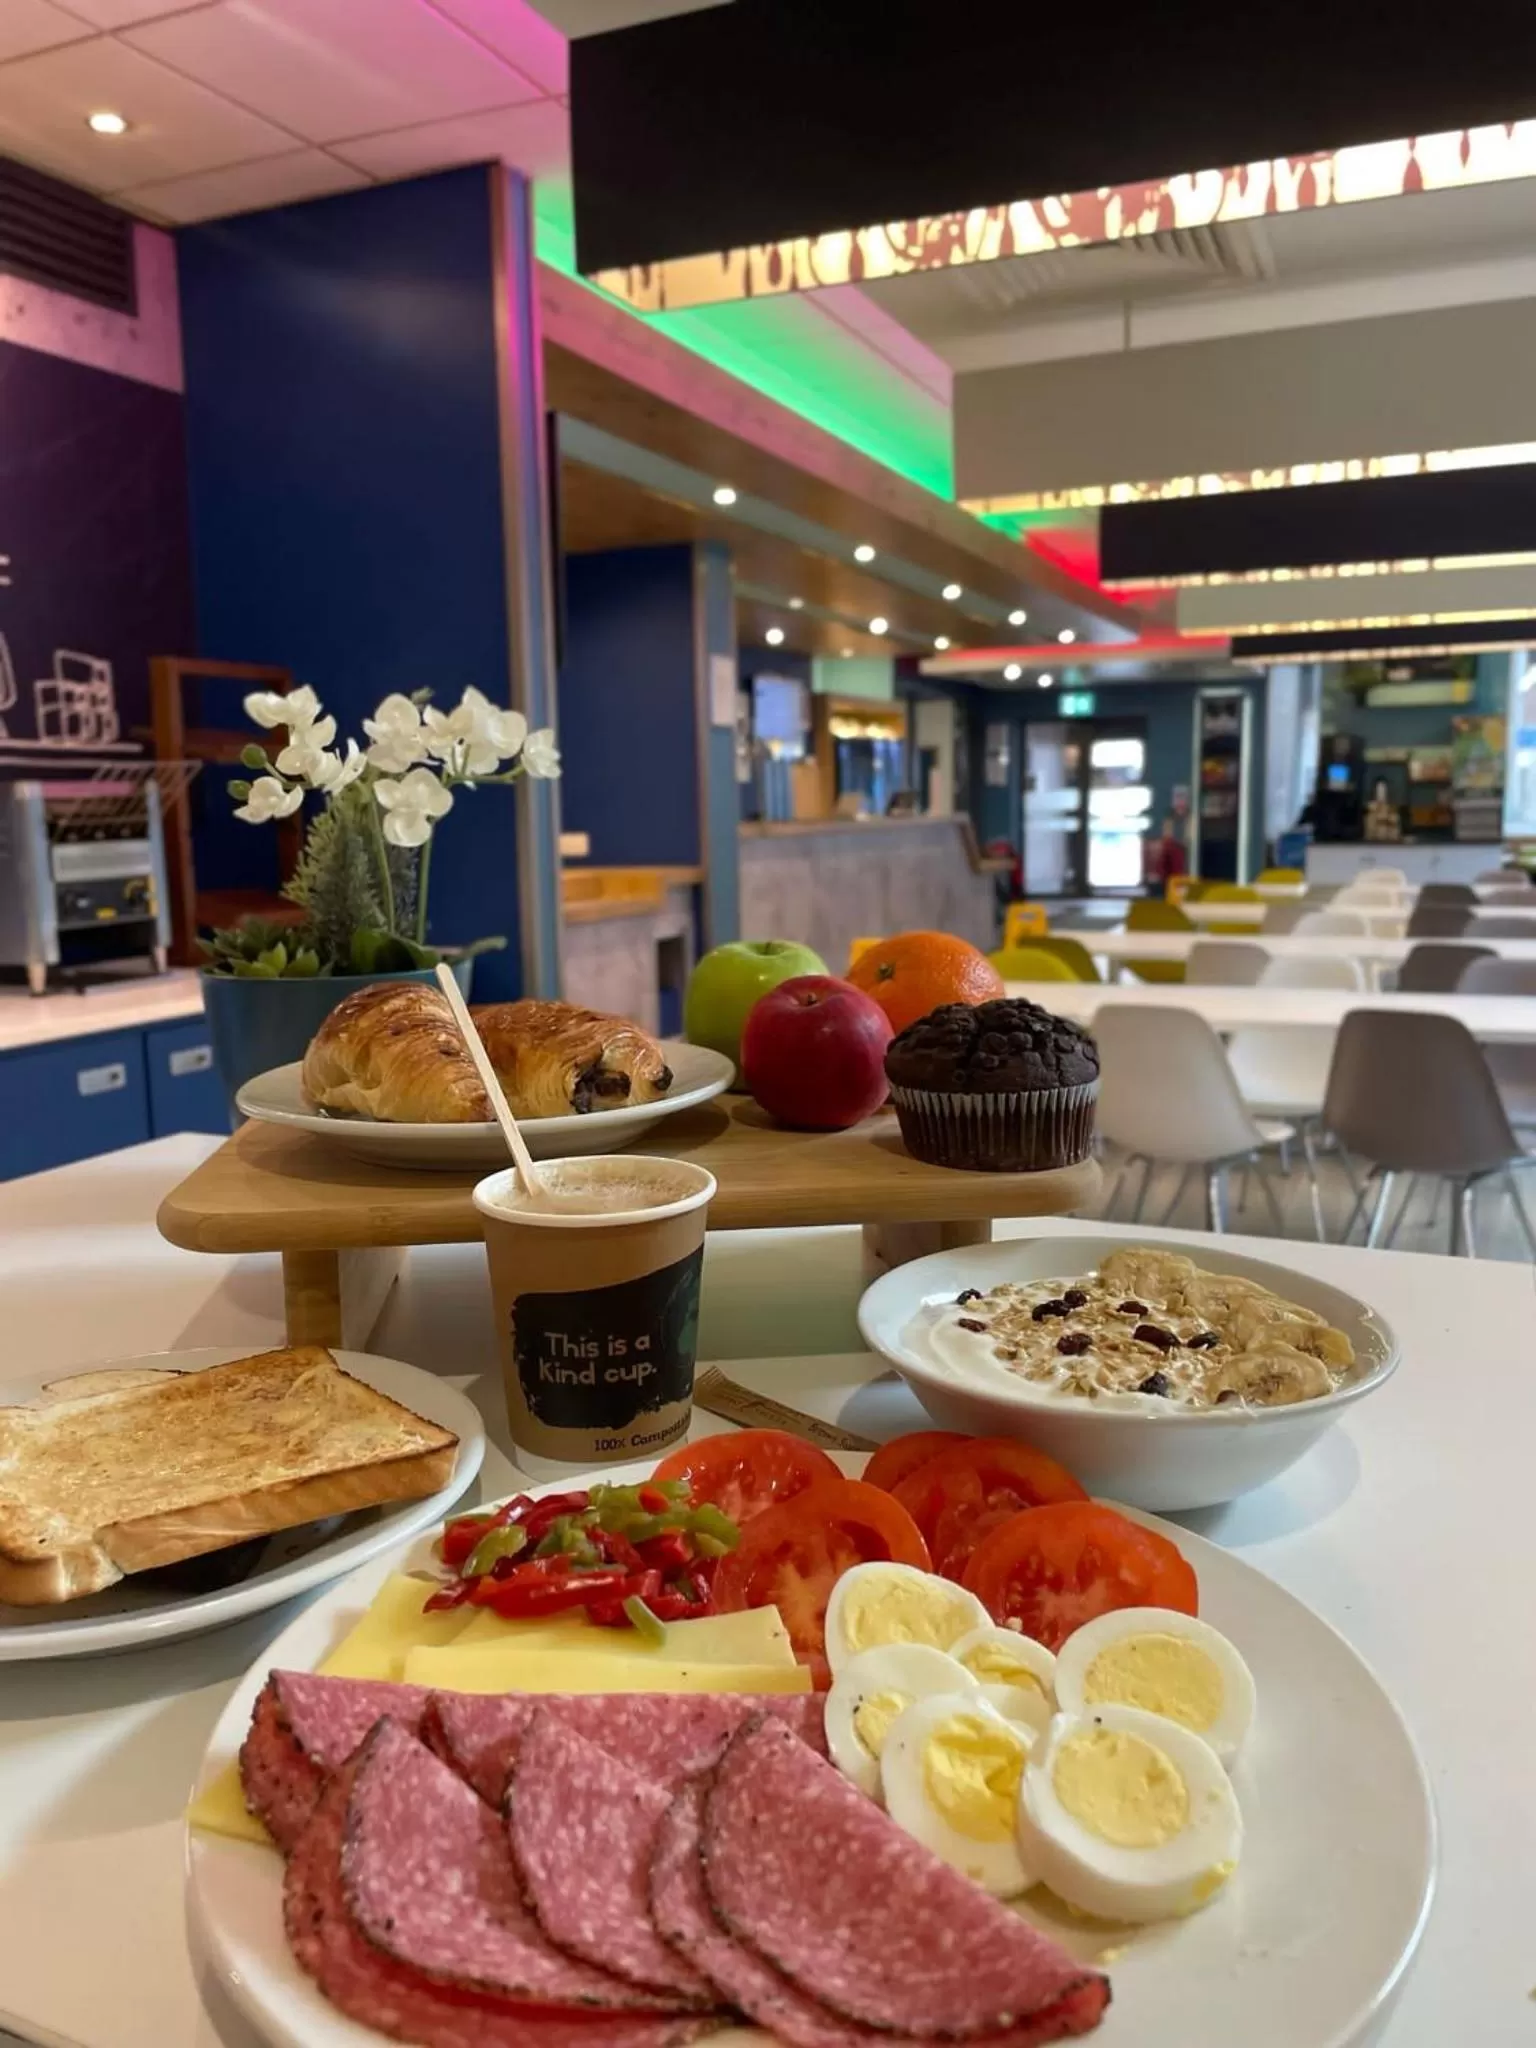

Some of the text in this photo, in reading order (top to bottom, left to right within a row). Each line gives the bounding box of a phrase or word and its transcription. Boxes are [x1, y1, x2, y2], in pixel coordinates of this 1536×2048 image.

[544, 1331, 651, 1358] This is a
[604, 1361, 657, 1388] cup.
[594, 1438, 626, 1452] 100%
